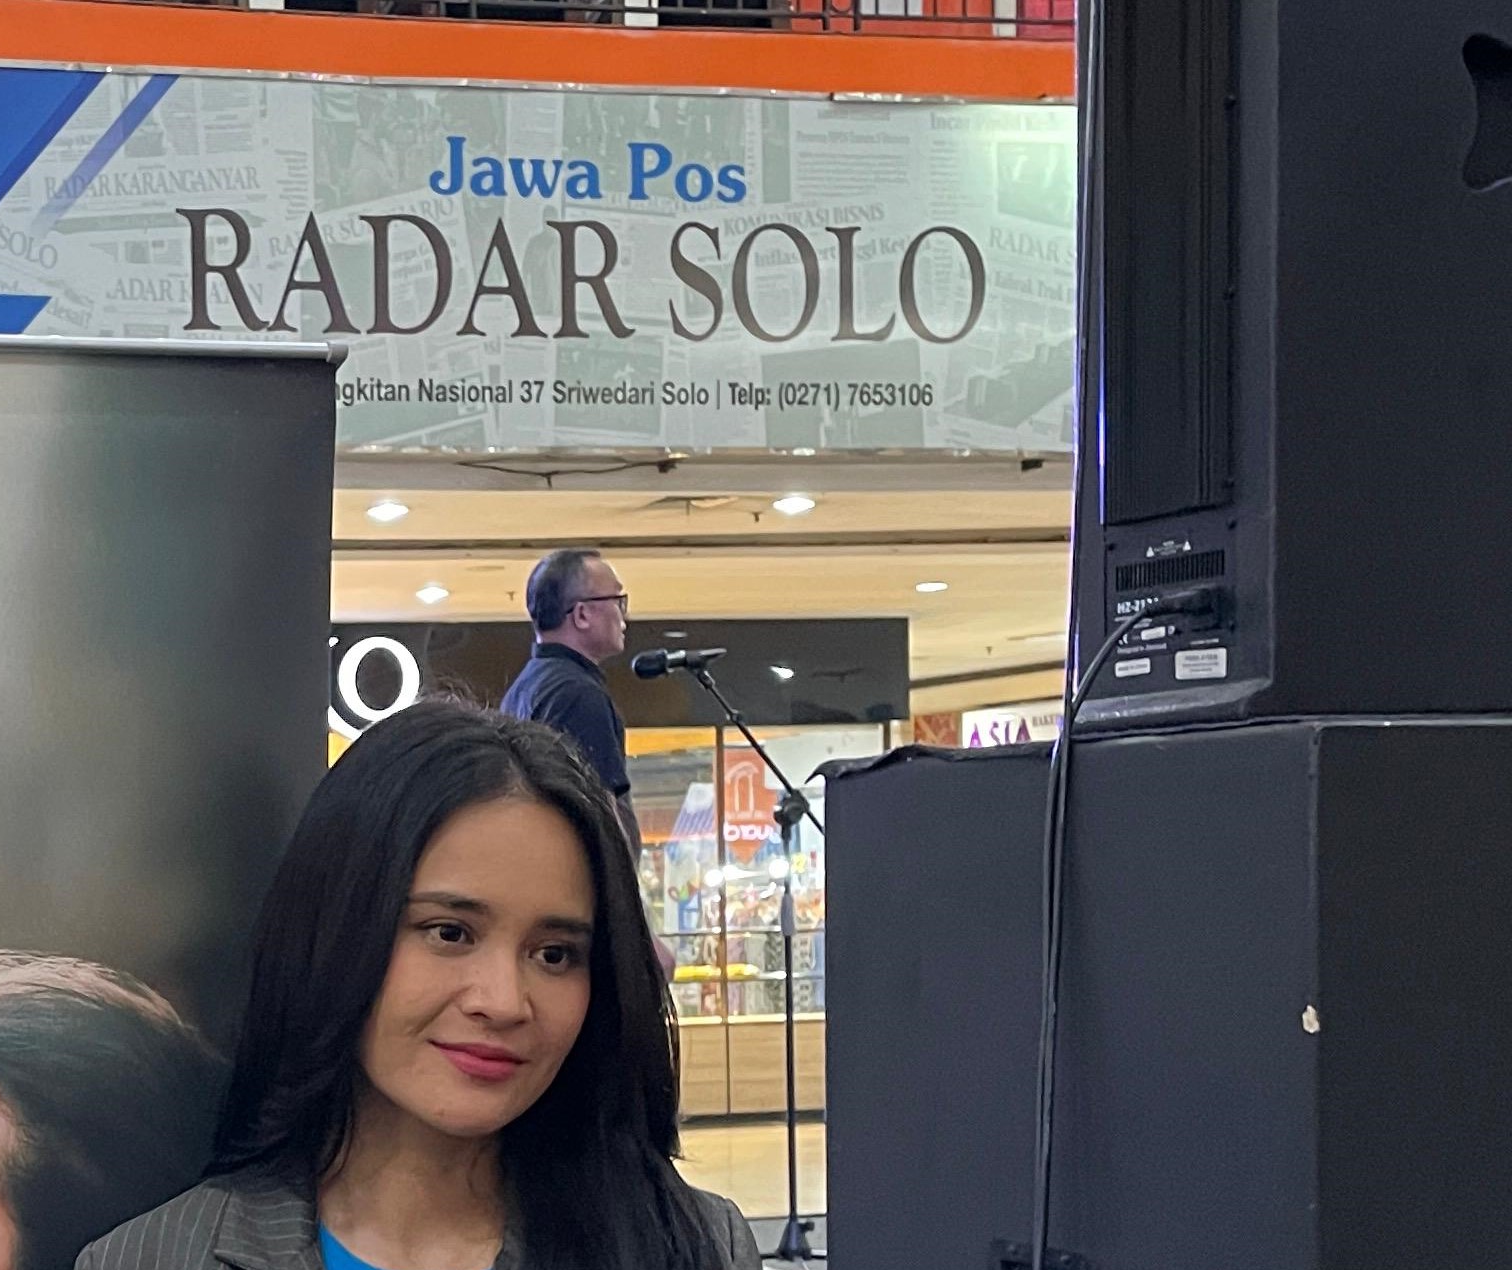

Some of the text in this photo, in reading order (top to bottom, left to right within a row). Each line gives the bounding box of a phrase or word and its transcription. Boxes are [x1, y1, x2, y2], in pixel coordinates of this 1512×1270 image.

[429, 136, 603, 200] Jawa
[627, 142, 748, 203] Pos
[107, 277, 181, 302] ADAR
[175, 207, 986, 344] RADAR SOLO
[418, 378, 513, 404] Nasional
[520, 379, 545, 404] 37
[552, 380, 655, 406] Sriwedari
[661, 382, 709, 406] Solo
[728, 382, 771, 410] Telp:
[777, 381, 840, 410] (0271)
[847, 382, 934, 407] 7653106
